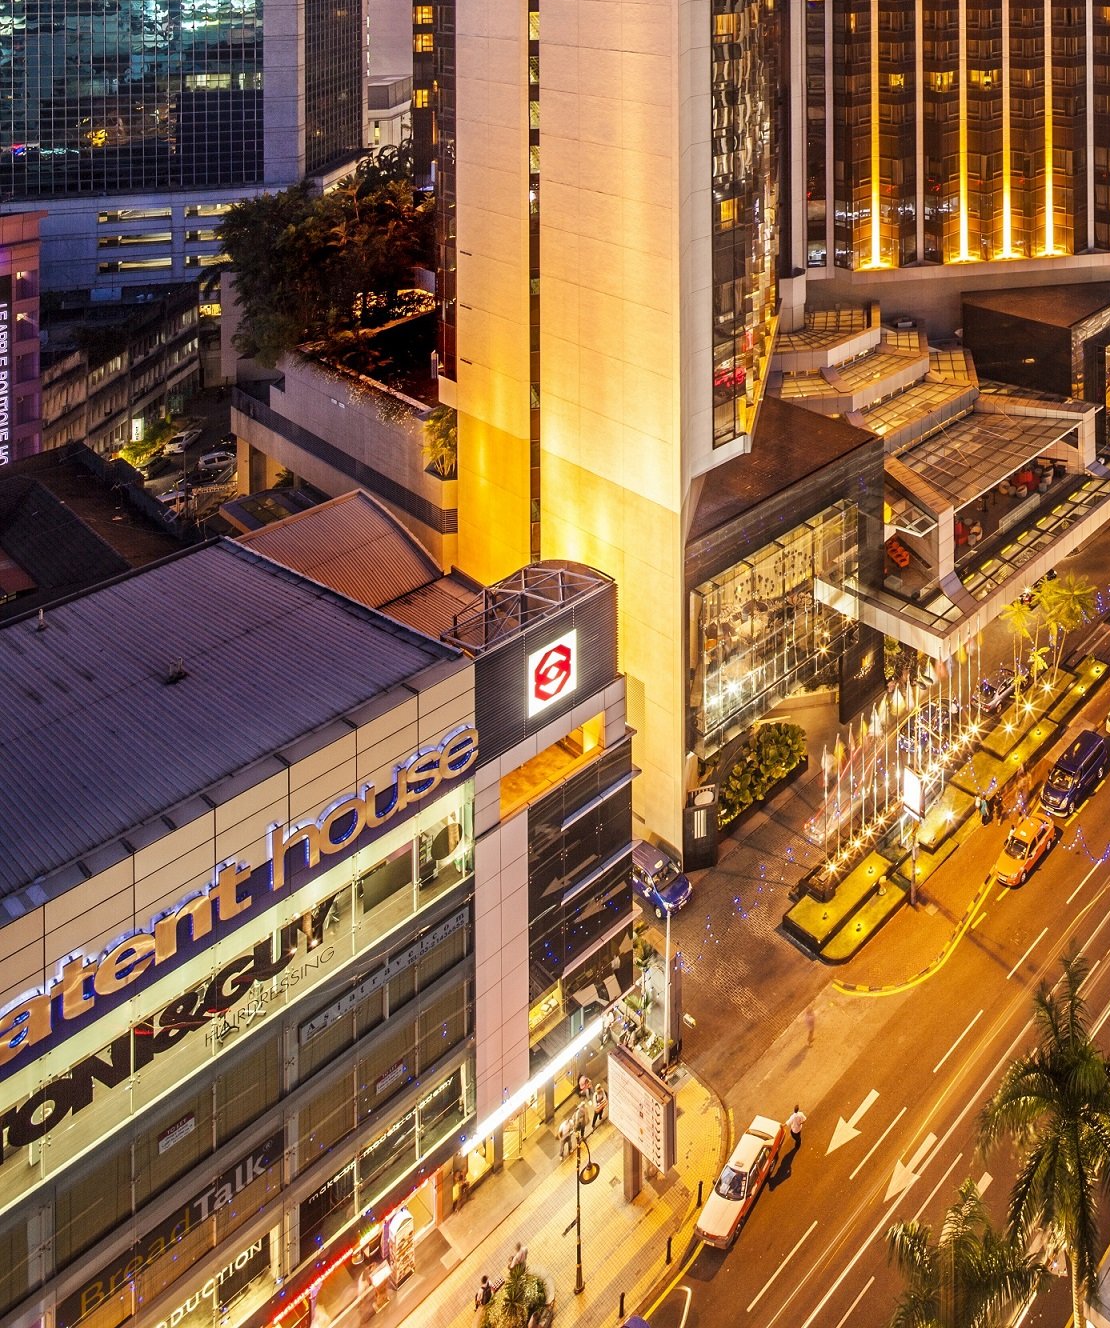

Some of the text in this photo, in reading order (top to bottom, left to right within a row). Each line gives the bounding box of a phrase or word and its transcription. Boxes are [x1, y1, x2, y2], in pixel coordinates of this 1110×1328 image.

[0, 725, 479, 1066] atent house
[204, 945, 335, 1047] HAIRDRESSING
